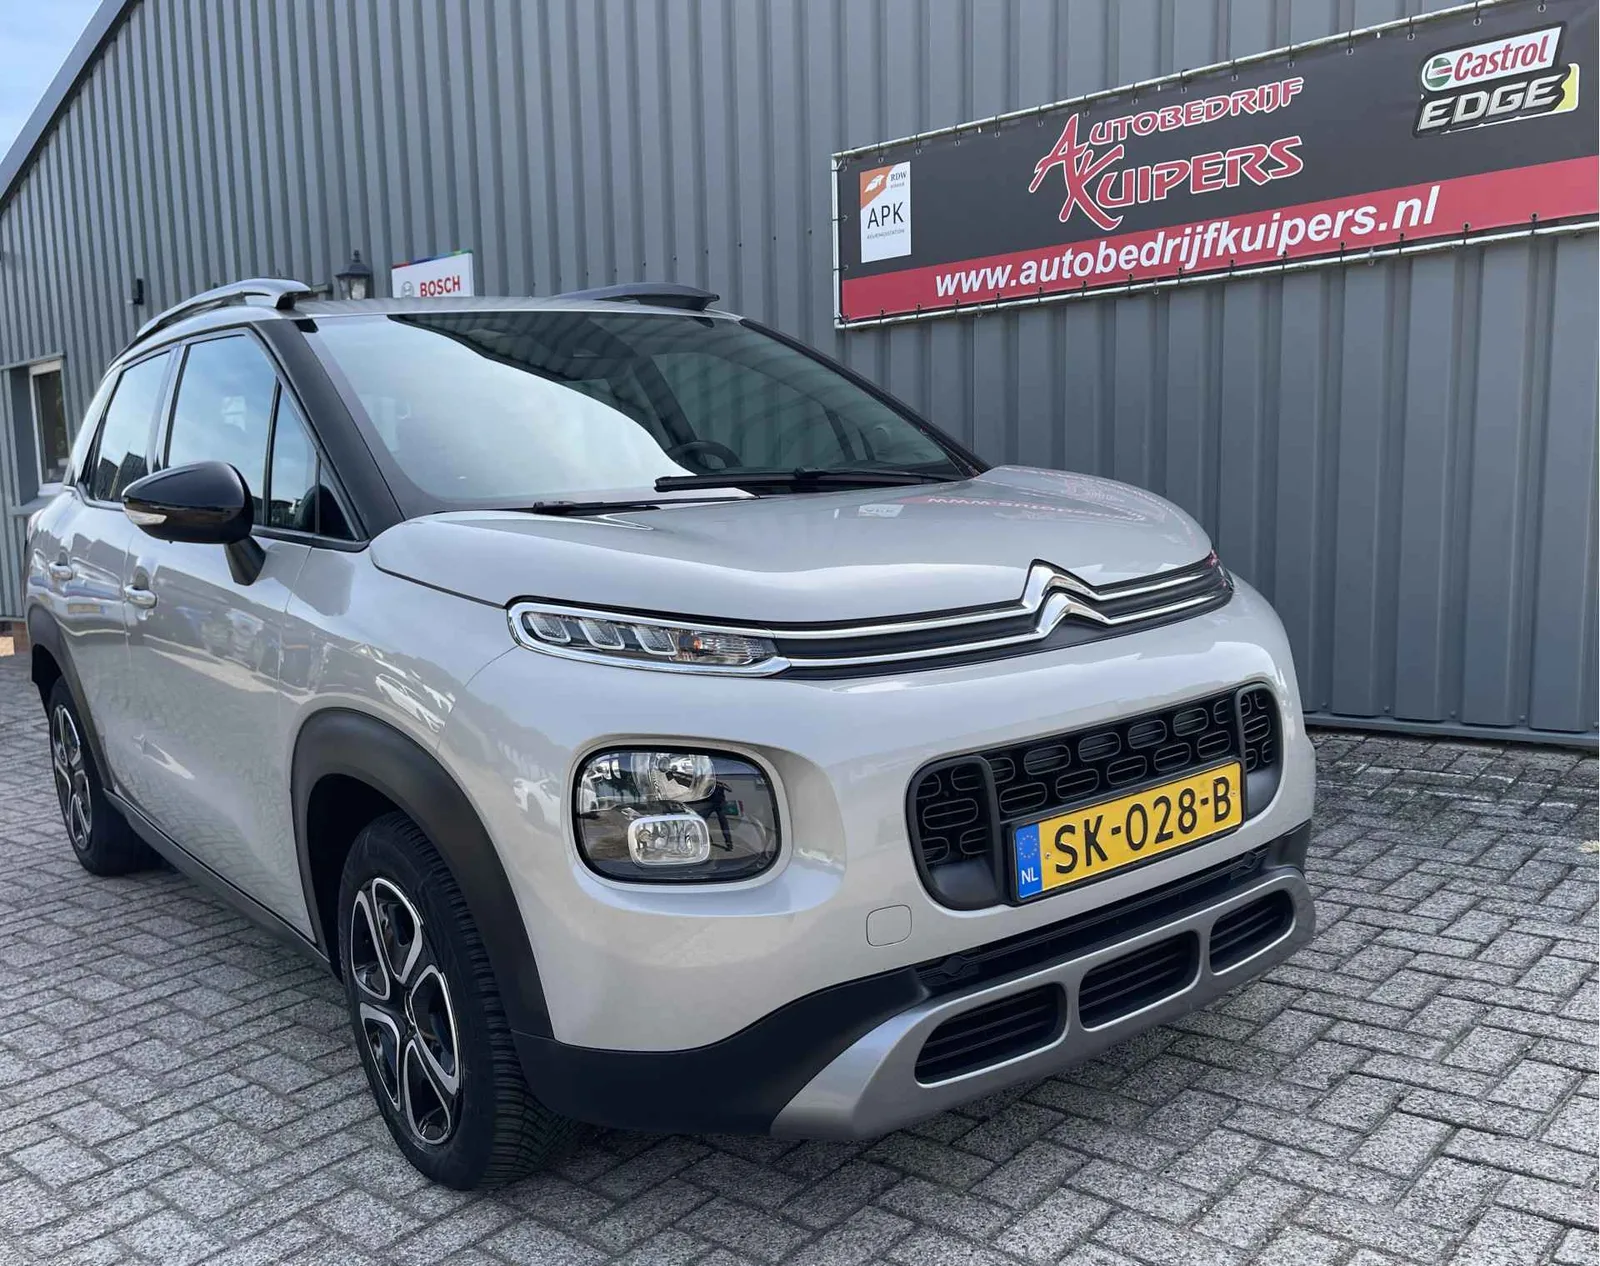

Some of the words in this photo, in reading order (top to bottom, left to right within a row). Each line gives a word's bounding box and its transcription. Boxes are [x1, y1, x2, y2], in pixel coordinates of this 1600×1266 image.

[1454, 35, 1549, 81] Castrol
[1418, 74, 1564, 132] EDGE
[1028, 77, 1304, 193] AUTOBEDRIJF
[891, 171, 907, 181] RDW
[1058, 136, 1304, 231] KUIPERS
[867, 201, 904, 229] APK
[936, 186, 1440, 297] www.autobedrijfkuipers.nl
[420, 275, 460, 297] BOSCH
[1055, 776, 1232, 874] SK-028-B
[1021, 867, 1039, 885] NL
